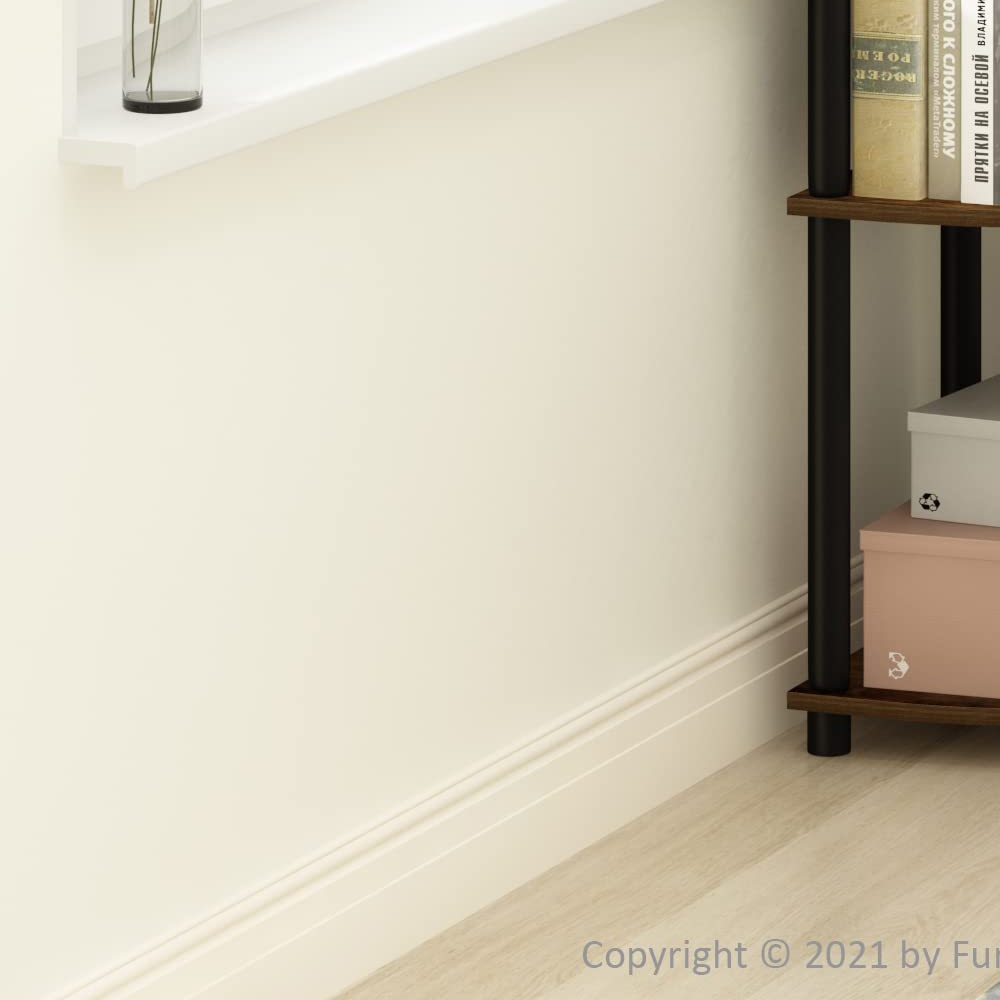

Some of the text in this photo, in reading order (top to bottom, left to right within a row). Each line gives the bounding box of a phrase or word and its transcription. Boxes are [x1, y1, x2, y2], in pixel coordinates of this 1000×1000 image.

[943, 37, 956, 49] К
[856, 49, 911, 64] POEM
[855, 69, 917, 83] ROGER
[942, 53, 956, 159] СЛОЖНОМУ
[972, 54, 989, 183] ПРЯТКИ НА ОСЕВОЙ
